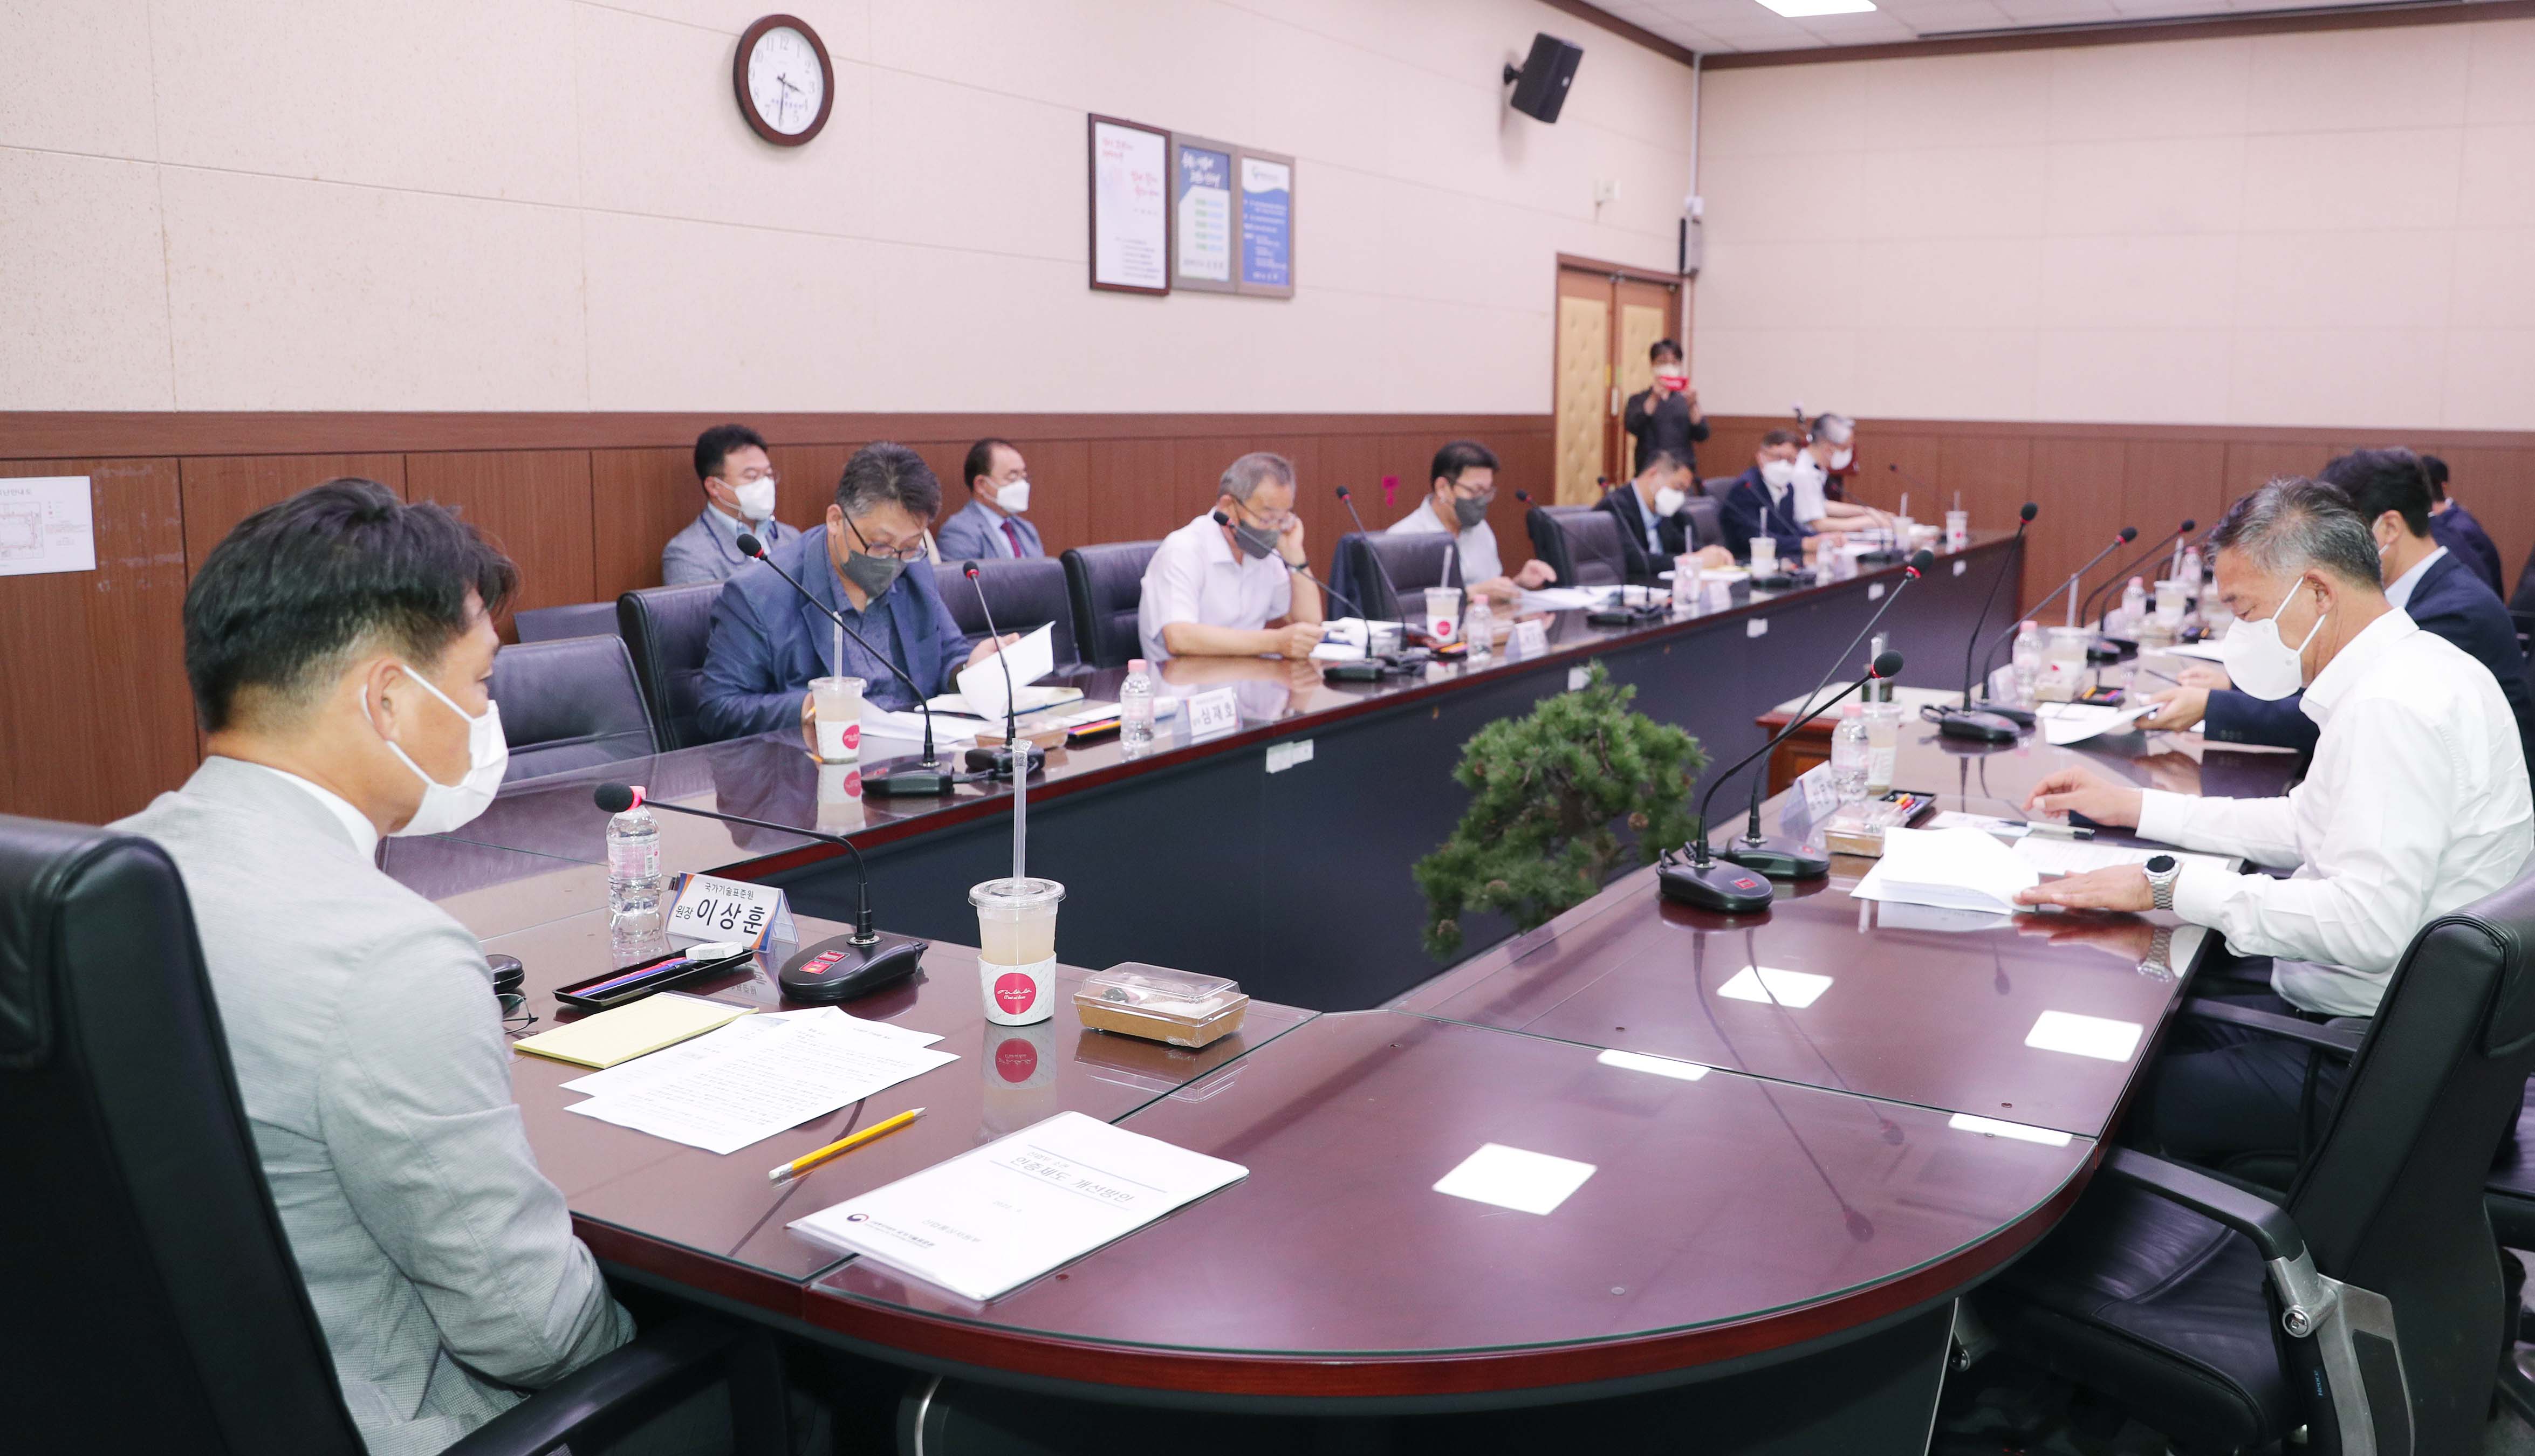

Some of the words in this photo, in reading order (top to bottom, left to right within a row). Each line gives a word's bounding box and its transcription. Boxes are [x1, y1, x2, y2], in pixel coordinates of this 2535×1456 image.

[766, 36, 774, 52] 11
[779, 34, 790, 51] 12
[705, 882, 754, 900] 국가기술표준원
[675, 905, 694, 920] 원장
[697, 899, 765, 935] 이상훈
[1010, 1156, 1072, 1181] 인증제도
[1070, 1178, 1135, 1203] 개선방안
